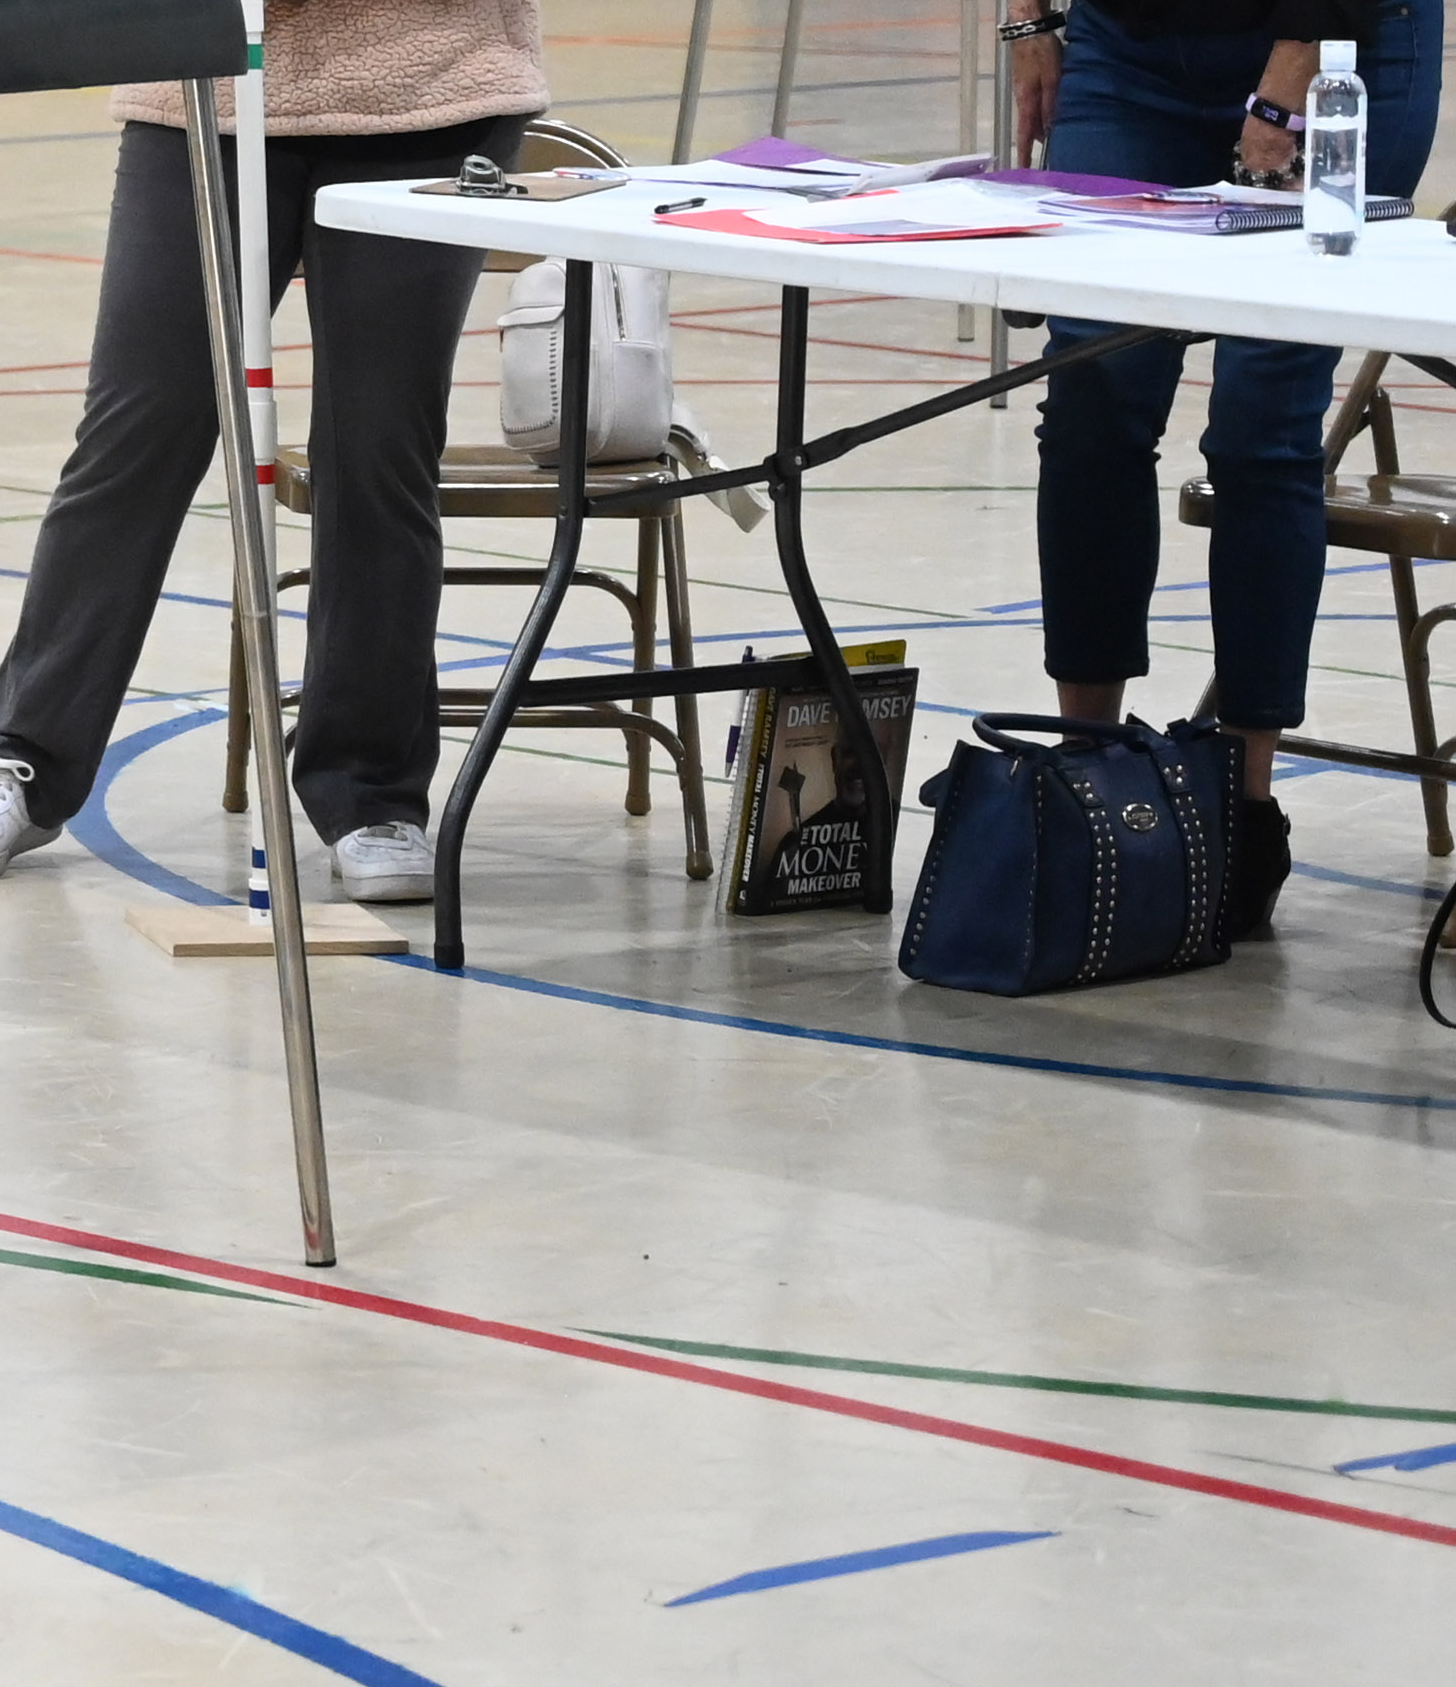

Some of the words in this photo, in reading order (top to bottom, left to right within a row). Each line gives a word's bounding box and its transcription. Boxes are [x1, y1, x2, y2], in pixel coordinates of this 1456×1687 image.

[787, 702, 833, 728] DAVE
[811, 822, 862, 845] TOTAL
[776, 843, 867, 878] MONE
[787, 872, 862, 895] MAKEOVER
